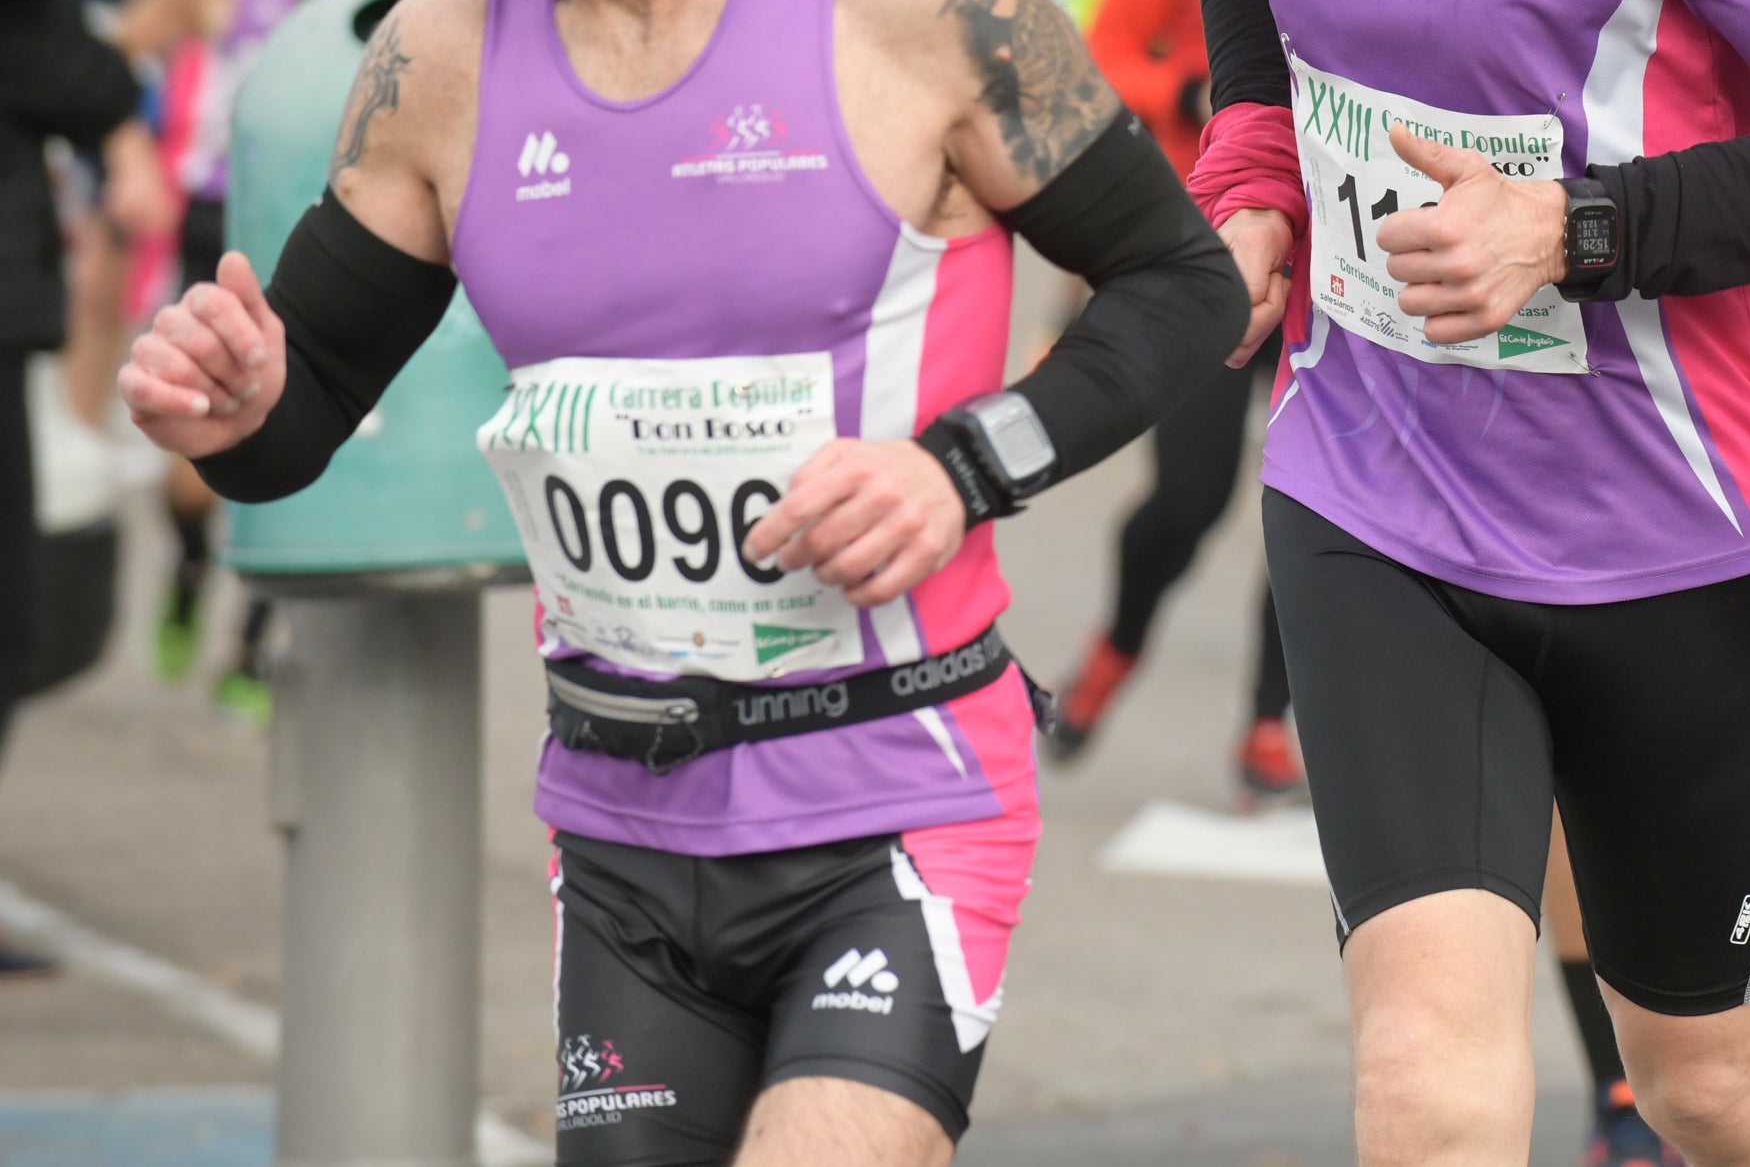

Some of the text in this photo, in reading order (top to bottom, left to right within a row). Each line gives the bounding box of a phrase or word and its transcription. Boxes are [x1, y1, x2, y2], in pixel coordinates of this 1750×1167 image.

[1304, 76, 1372, 162] XXIII
[1460, 129, 1552, 156] Popular
[516, 178, 571, 201] mobel
[1320, 292, 1355, 314] salesianos
[1382, 285, 1395, 299] en
[609, 383, 700, 410] Carrera
[545, 473, 788, 584] 0096
[891, 643, 986, 697] adidas
[812, 989, 893, 1016] mobel
[567, 1089, 677, 1117] POPULARES
